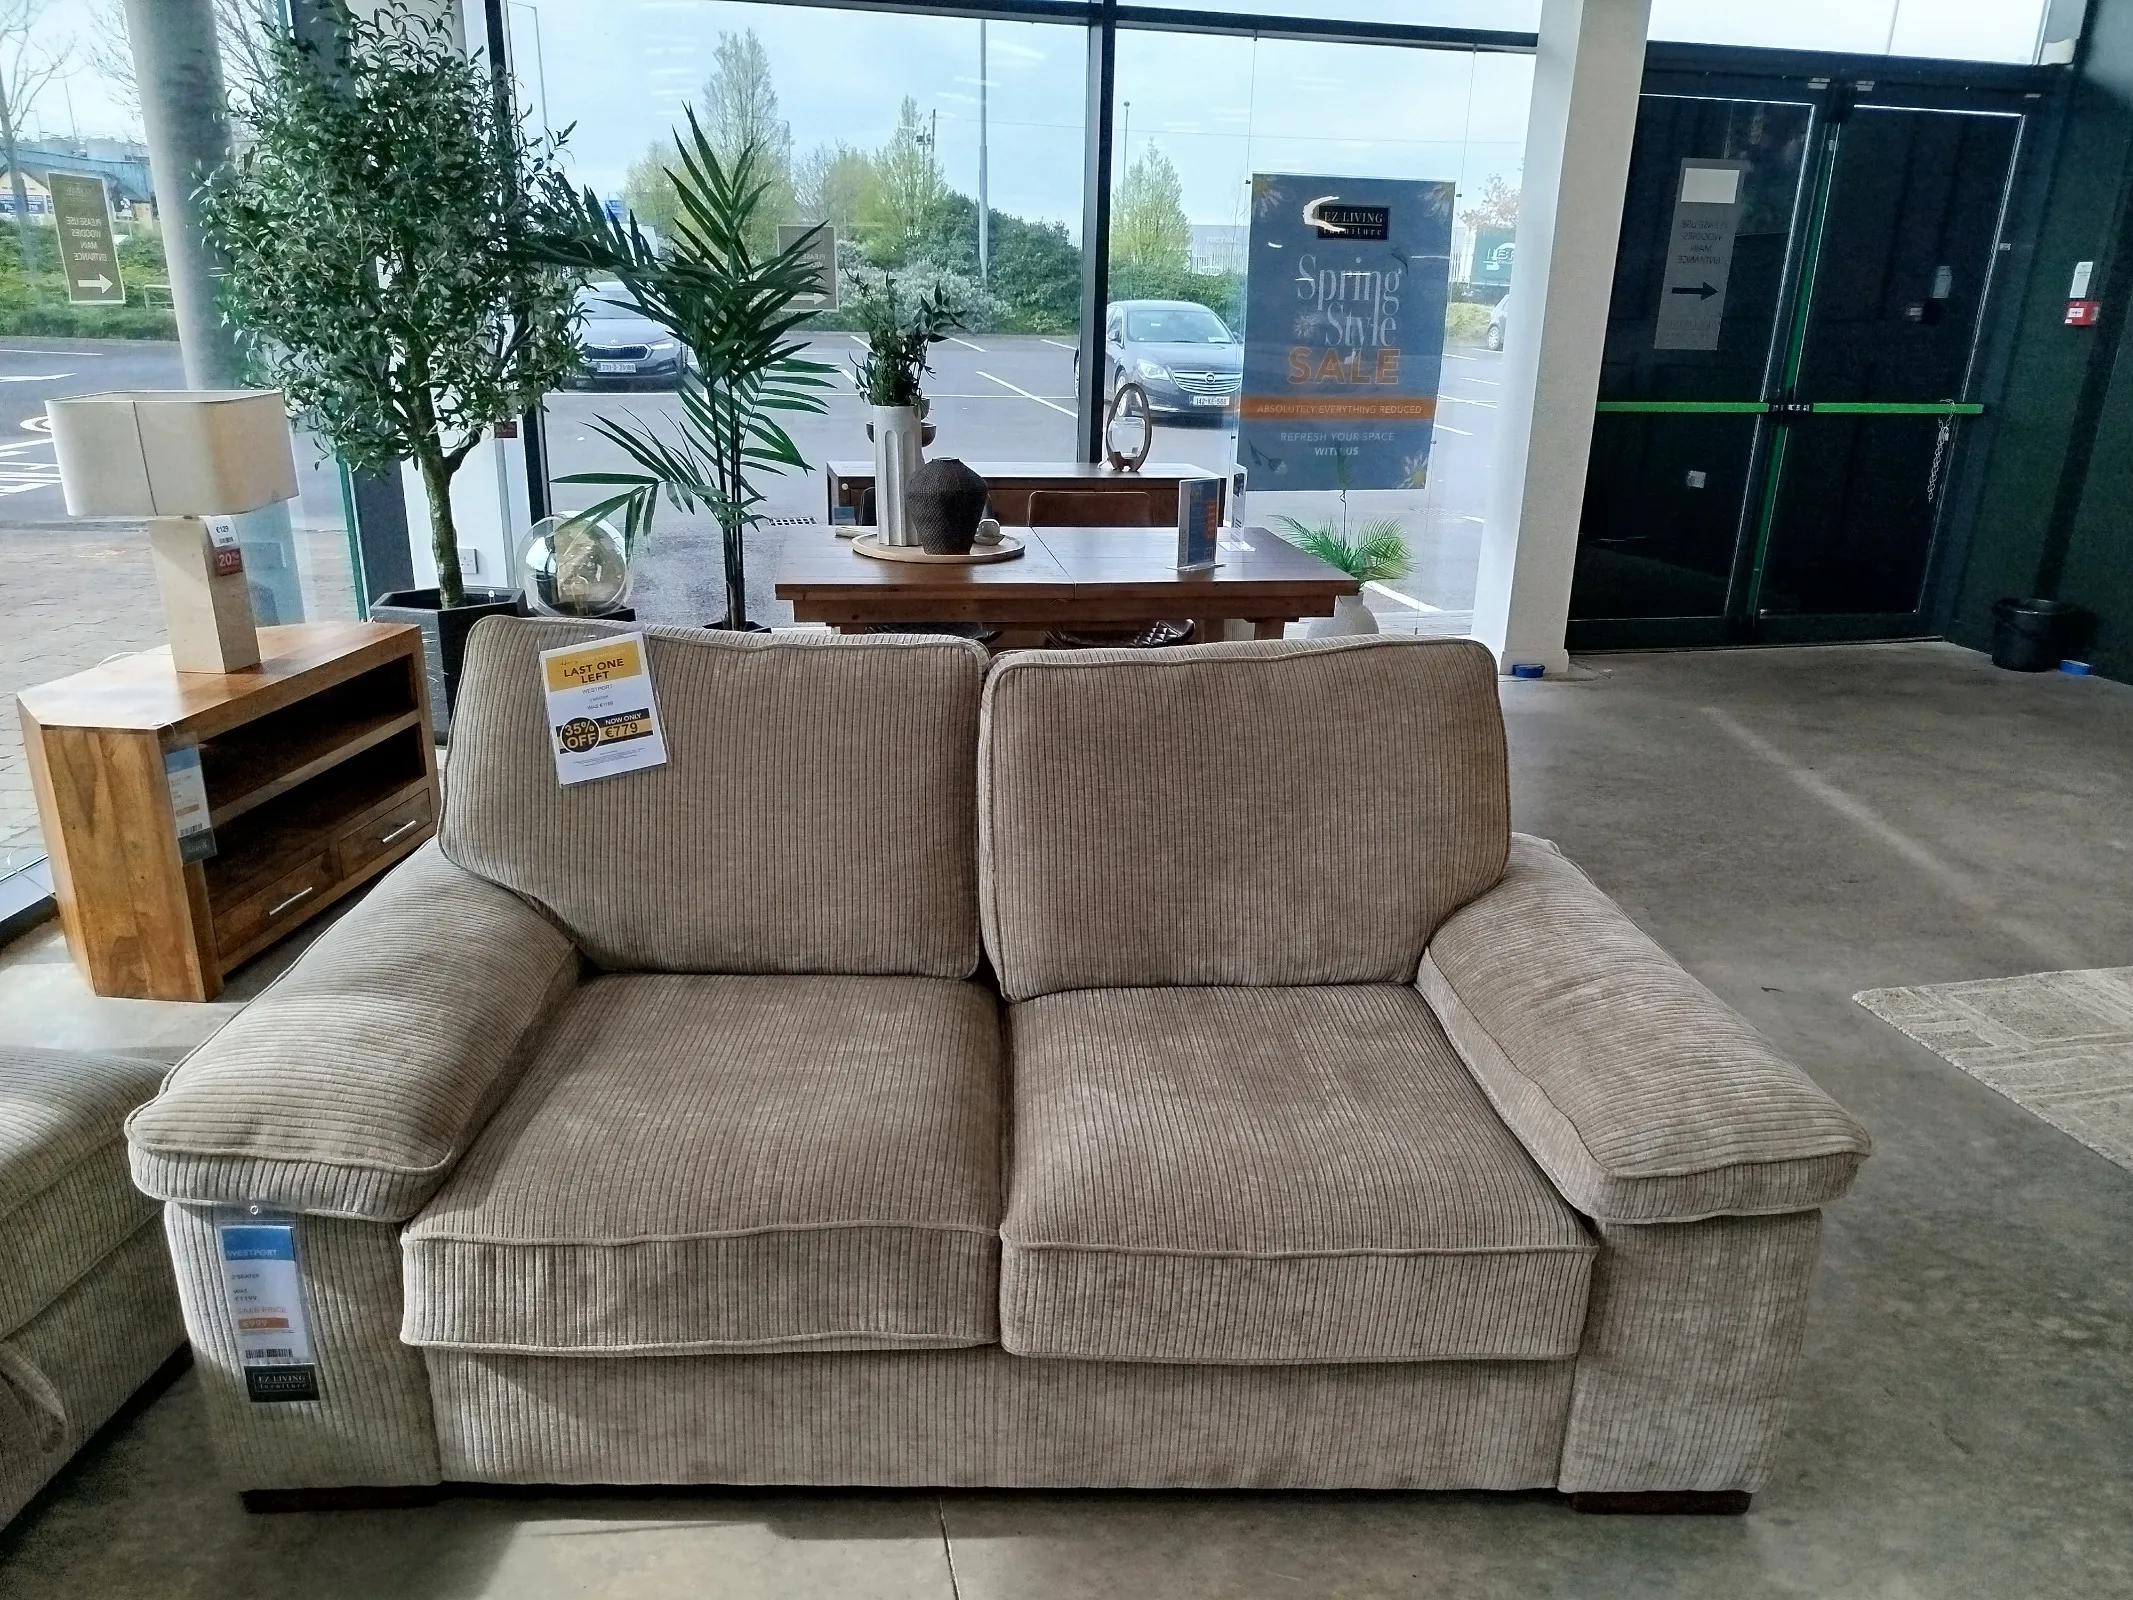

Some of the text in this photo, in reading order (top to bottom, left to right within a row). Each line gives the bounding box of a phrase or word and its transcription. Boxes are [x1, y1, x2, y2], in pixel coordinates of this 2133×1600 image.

[1324, 211, 1383, 223] EZ LIVING
[1297, 254, 1402, 316] Spring
[1325, 301, 1397, 351] Style
[1287, 346, 1401, 384] SALE
[1257, 404, 1422, 414] ABSOLUTELY EVERYTHING REDUCED
[1280, 432, 1395, 441] REFRESH YOUR SPACE
[1345, 446, 1359, 456] US
[564, 658, 624, 677] LAST ONE
[581, 671, 609, 683] LEFT
[605, 713, 641, 725] NOW ONLY
[565, 721, 638, 737] 35% €779
[567, 733, 596, 748] OFF
[227, 1249, 277, 1257] WESTPORT
